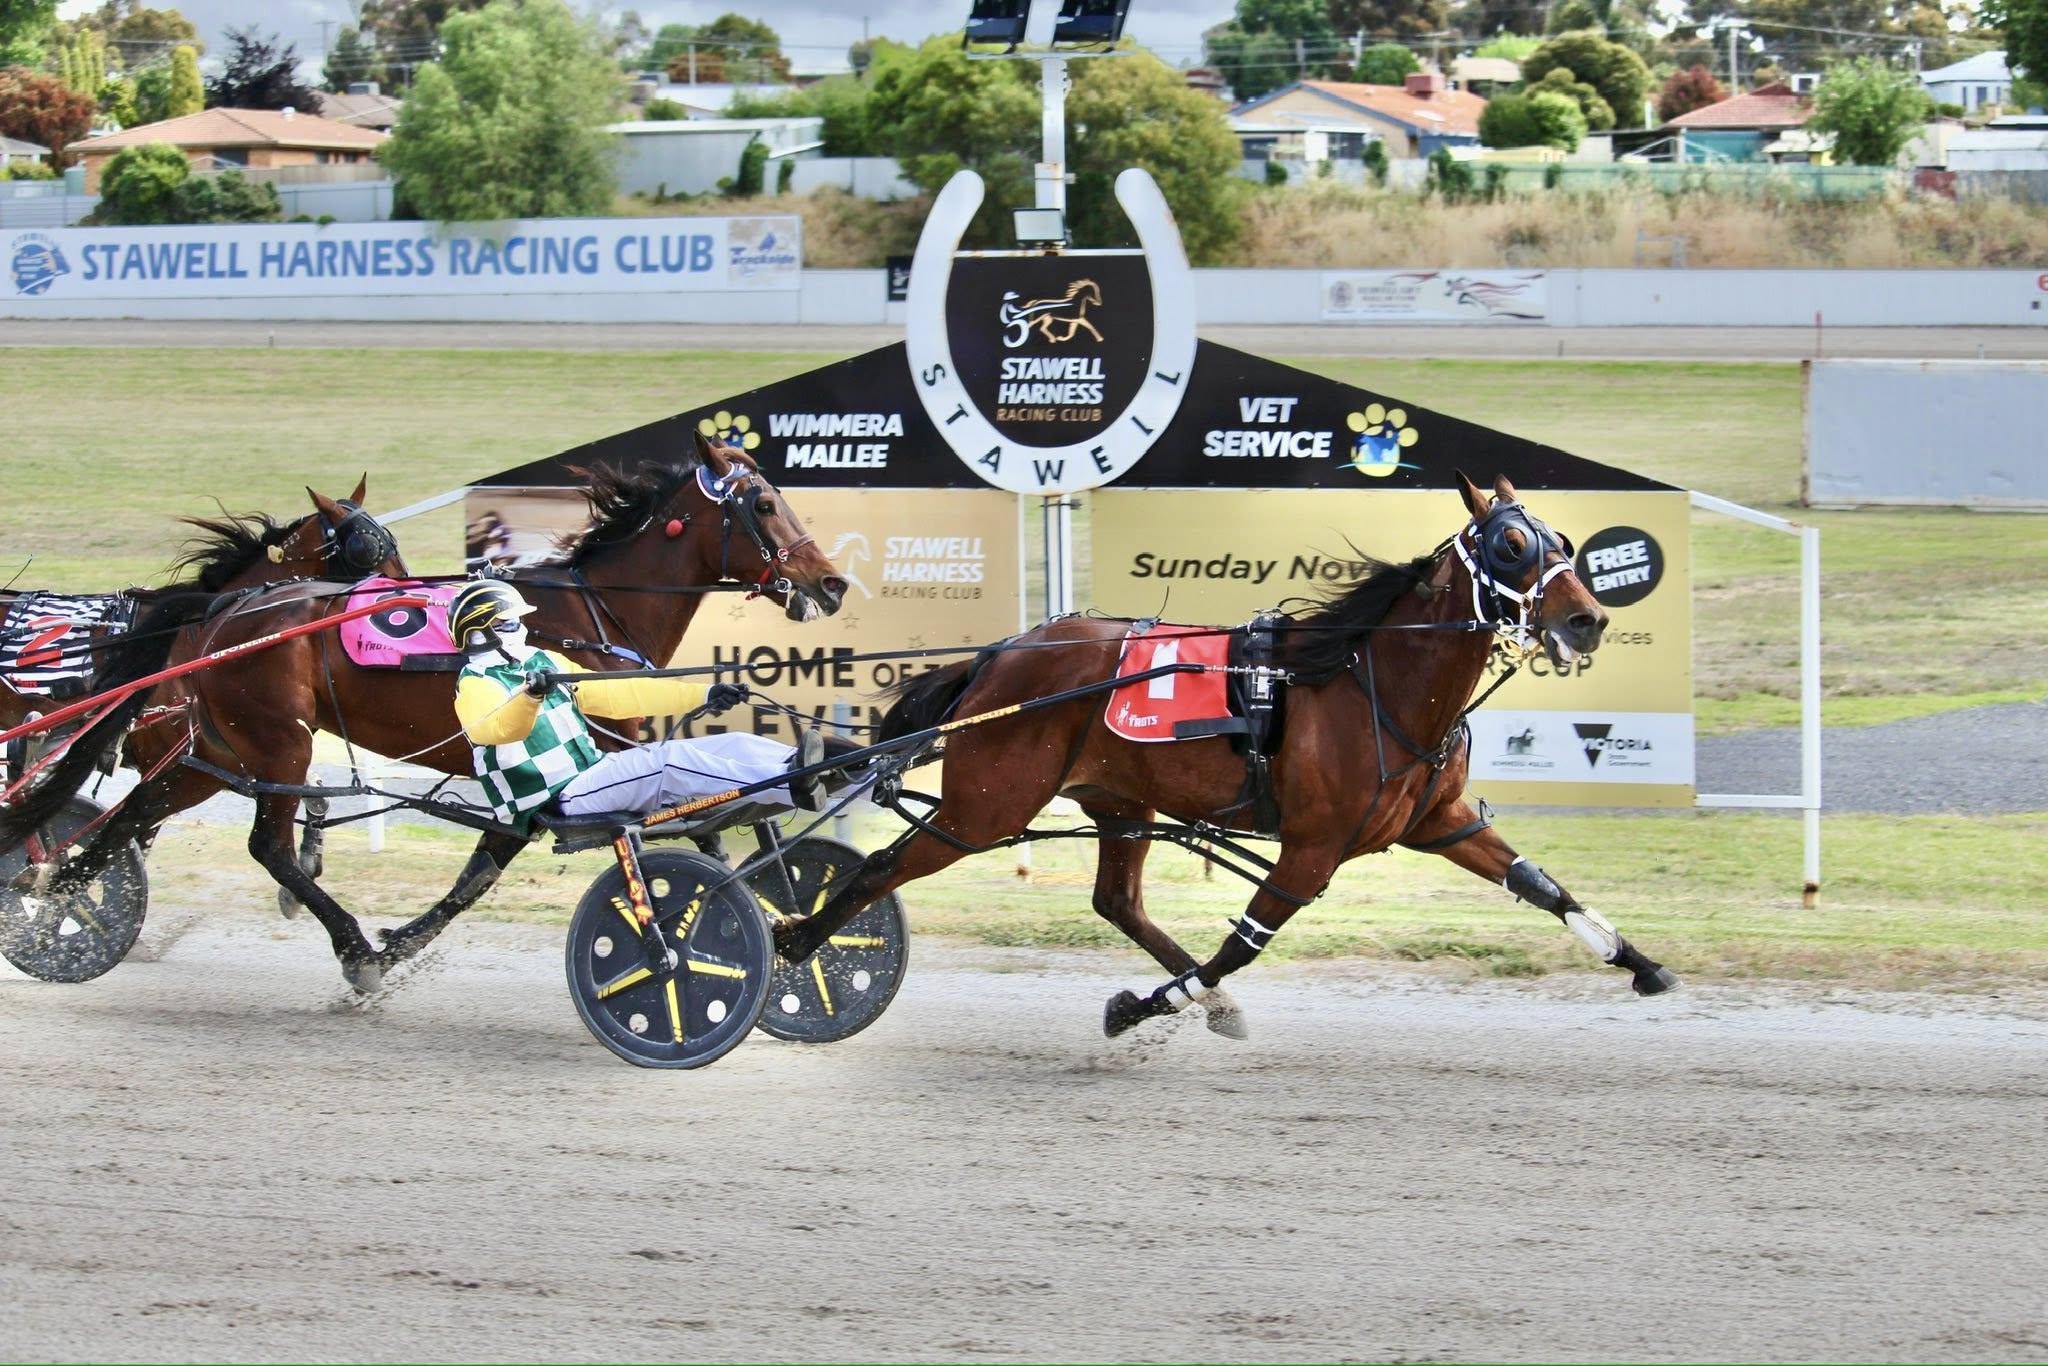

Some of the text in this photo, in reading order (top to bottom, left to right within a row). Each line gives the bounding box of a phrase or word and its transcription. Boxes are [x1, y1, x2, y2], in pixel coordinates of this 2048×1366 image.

[82, 242, 248, 281] STAWELL
[260, 239, 435, 279] HARNESS
[449, 236, 600, 277] RACING
[614, 234, 715, 274] CLUB
[1000, 357, 1105, 380] STAWELL
[998, 383, 1104, 405] HARNESS
[996, 408, 1102, 422] RACING CLUB
[1239, 397, 1298, 423] VET
[768, 413, 904, 437] WIMMERA
[922, 363, 1182, 486] STAWELL
[785, 443, 889, 468] MALLEE
[1203, 430, 1333, 458] SERVICE
[884, 536, 986, 559] STAWELL
[1585, 540, 1650, 573] FREE
[883, 562, 985, 583] HARNESS
[1130, 553, 1277, 584] Sunday
[1591, 564, 1652, 592] ENTRY
[881, 586, 982, 600] RACING CLUB
[16, 614, 73, 667] 2
[713, 645, 855, 688] HOME
[1148, 639, 1180, 700] 1
[644, 789, 741, 826] JAMES HERBERTSON
